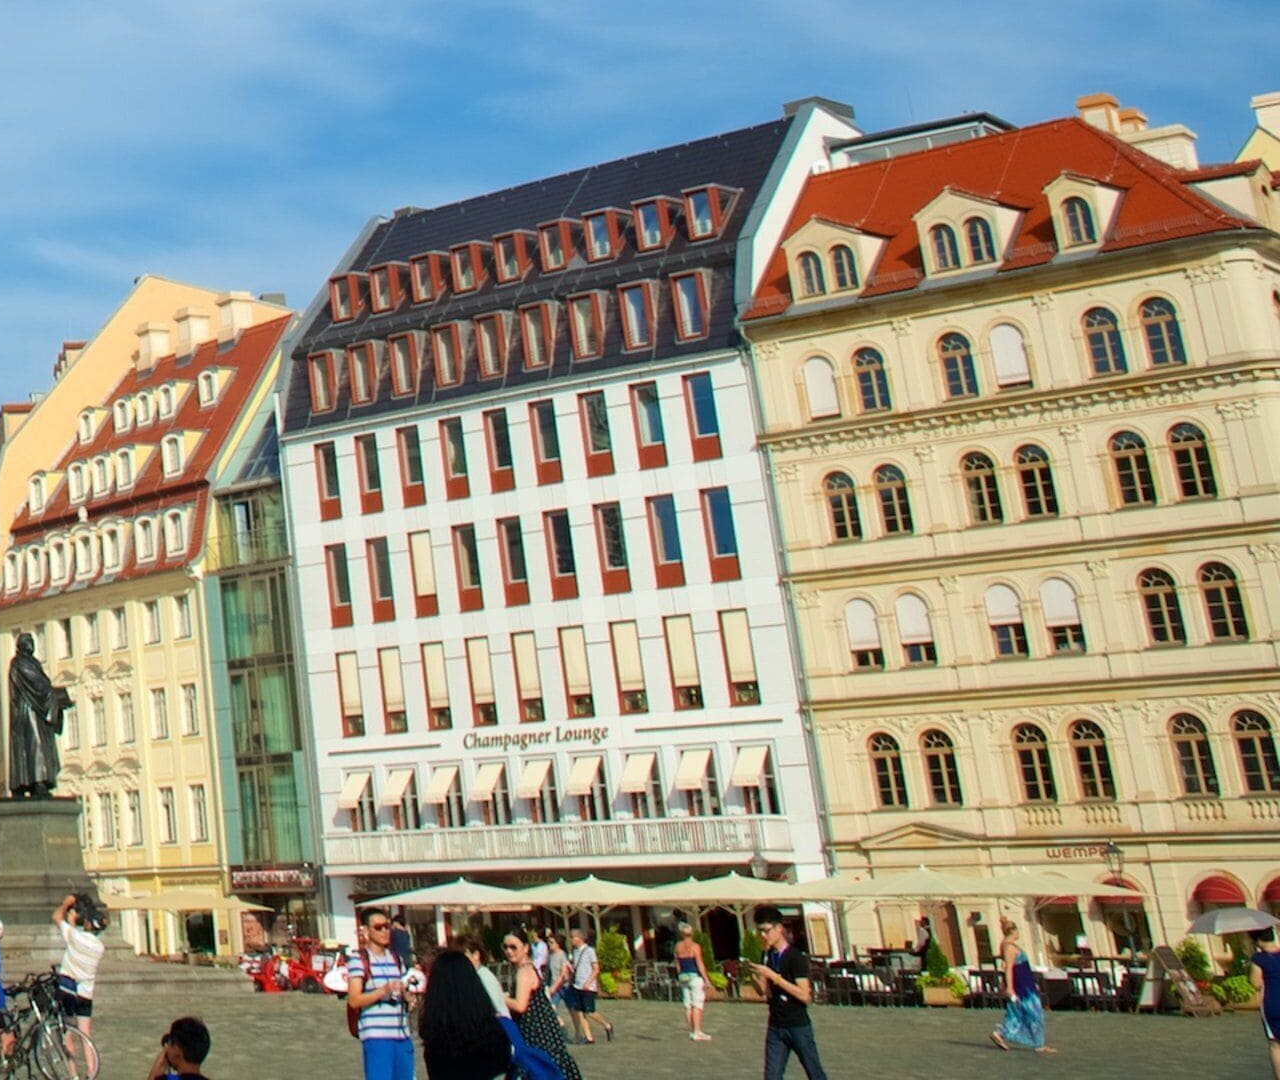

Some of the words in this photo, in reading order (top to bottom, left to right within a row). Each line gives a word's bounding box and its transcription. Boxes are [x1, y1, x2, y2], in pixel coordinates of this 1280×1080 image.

[846, 434, 907, 451] GOTTES
[923, 423, 976, 440] SEGEN
[1108, 393, 1195, 413] GELEGEN
[463, 731, 551, 751] Champagner
[556, 726, 609, 745] Lounge
